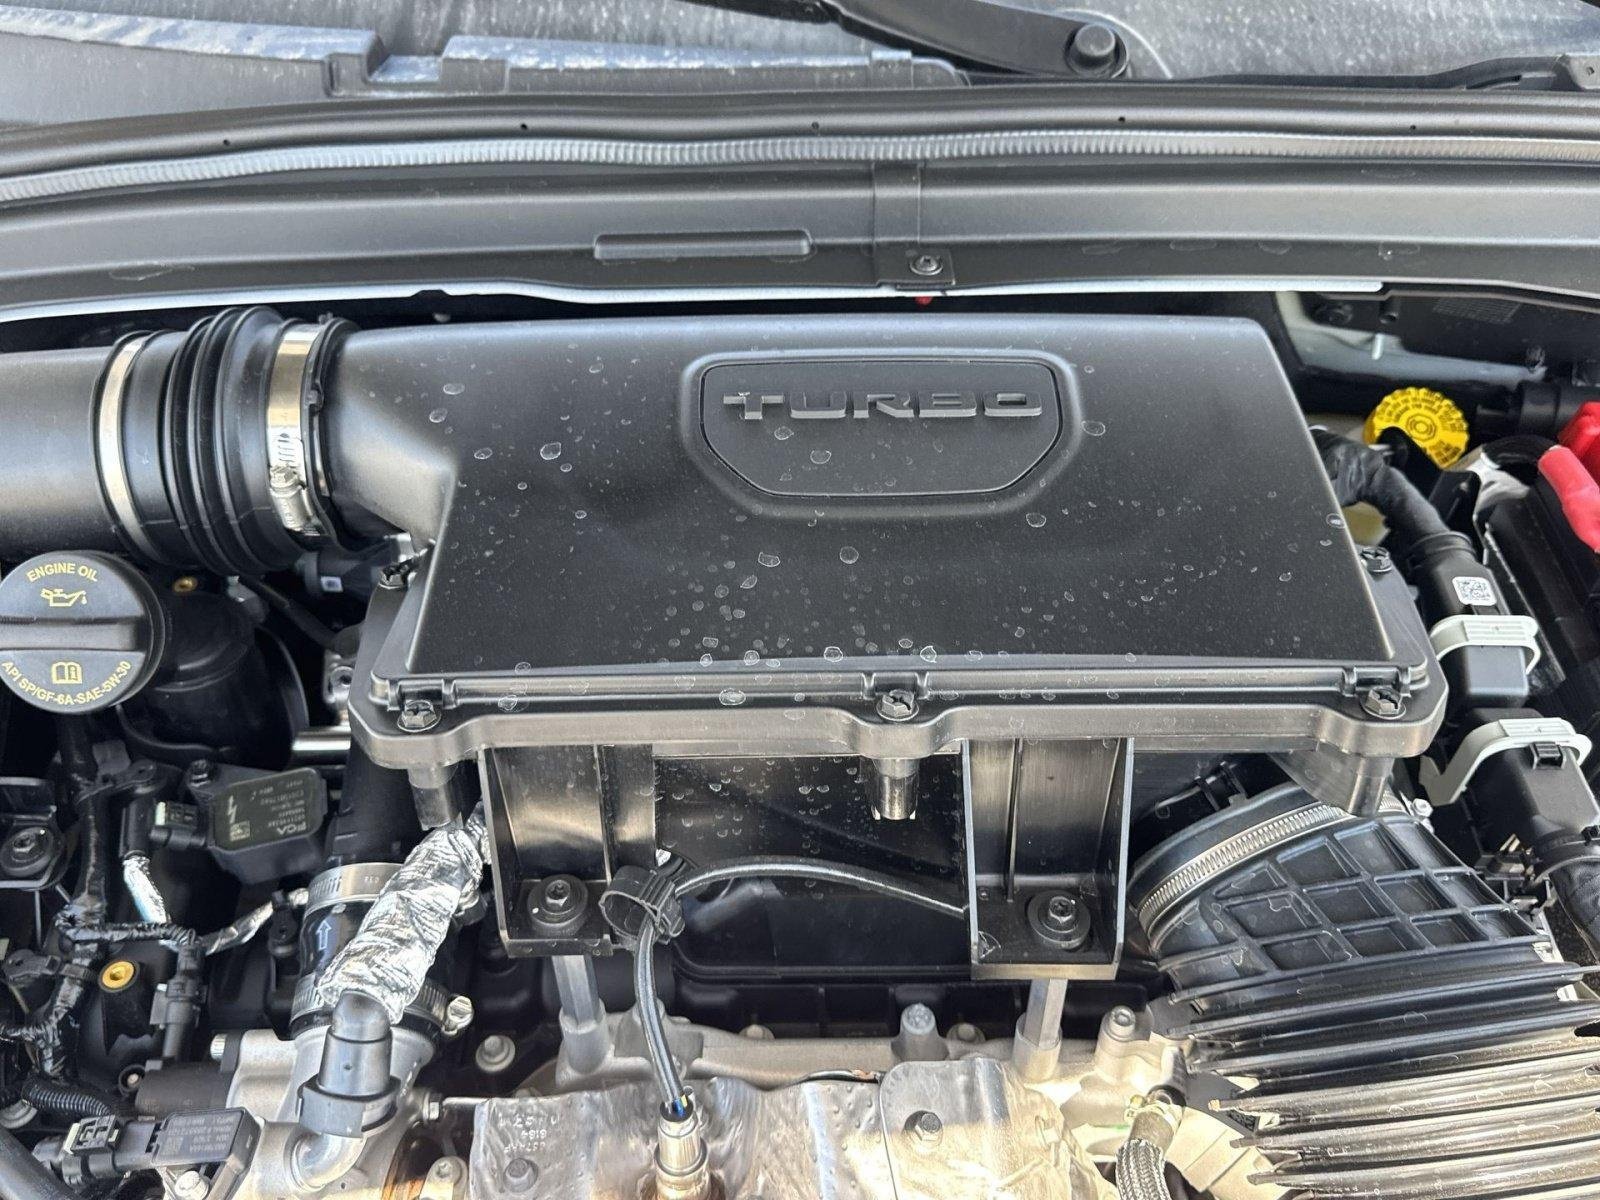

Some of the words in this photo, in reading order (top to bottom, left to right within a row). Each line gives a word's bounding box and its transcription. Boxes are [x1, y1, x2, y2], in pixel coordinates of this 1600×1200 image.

[723, 390, 1043, 420] TURBO
[26, 562, 76, 583] ENGINE
[77, 564, 99, 583] OIL
[2, 661, 19, 682] API
